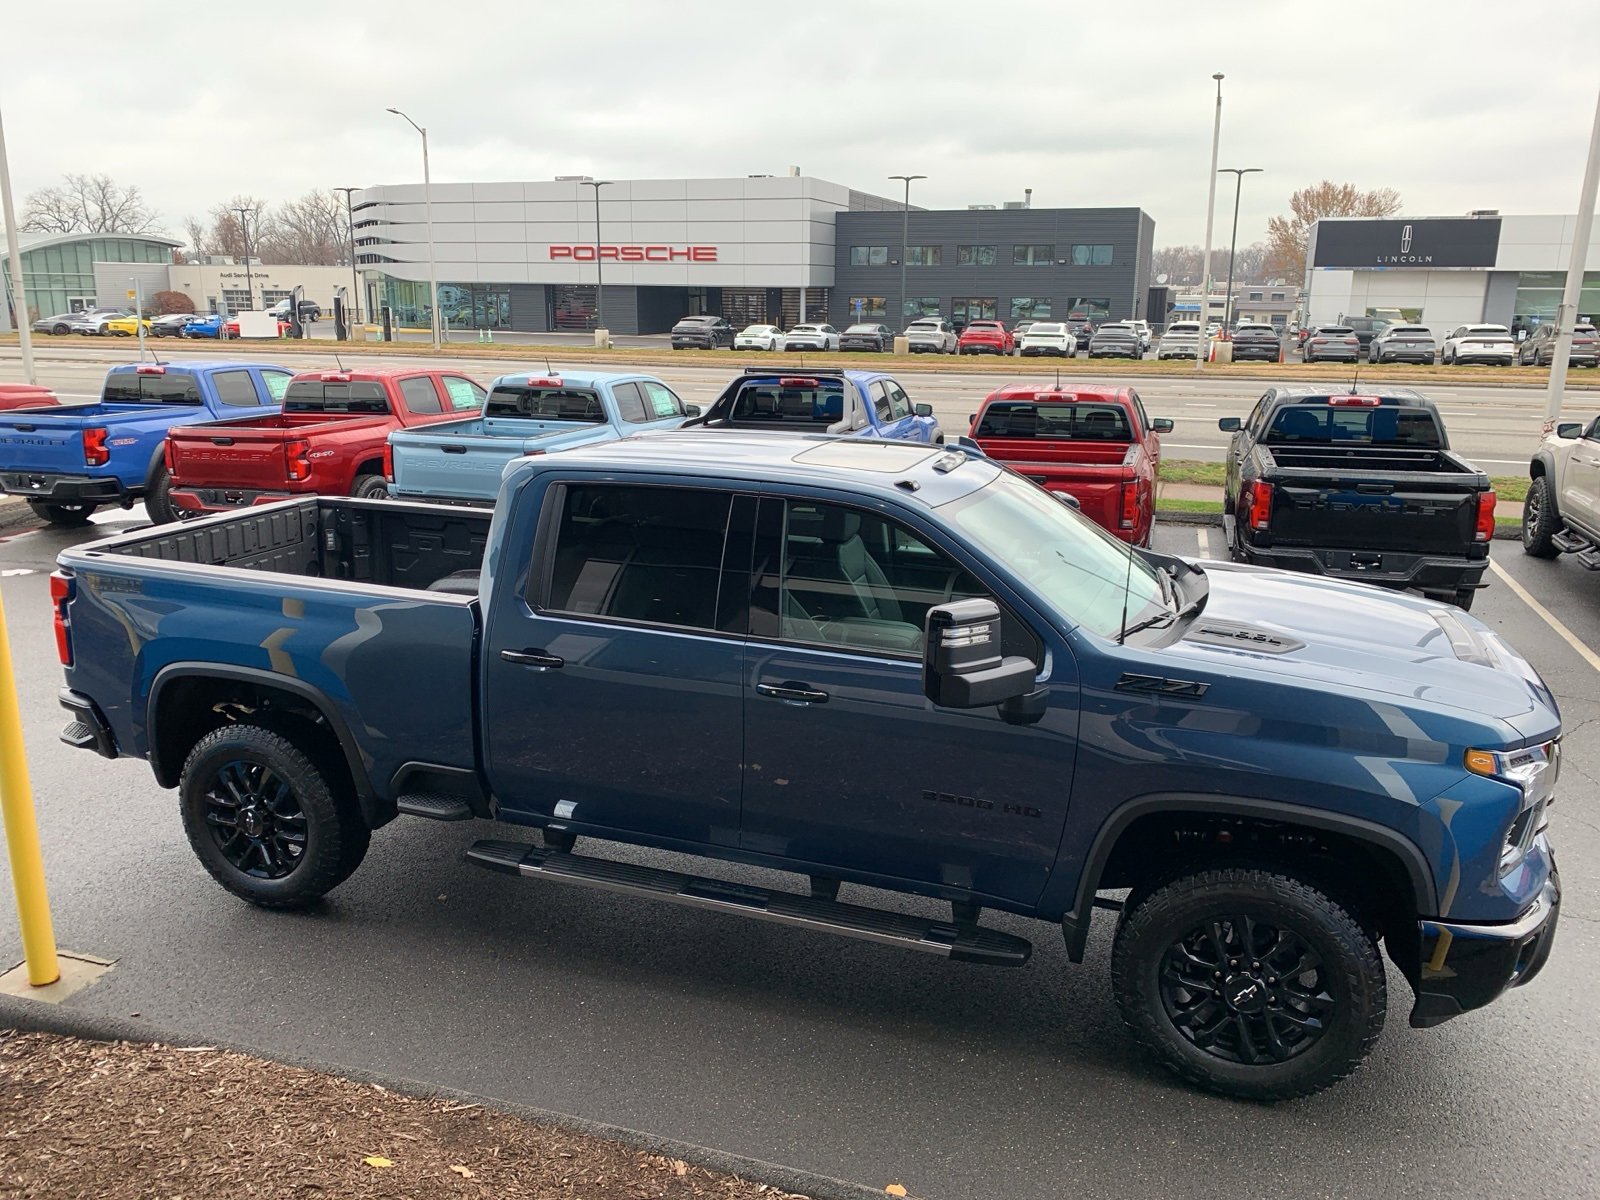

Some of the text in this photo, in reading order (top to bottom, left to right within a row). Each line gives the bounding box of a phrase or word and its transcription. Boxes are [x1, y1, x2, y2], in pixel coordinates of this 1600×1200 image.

[549, 246, 718, 261] PORSCHE
[1377, 255, 1433, 263] LINCOLN
[181, 451, 271, 462] CHEVROLET
[1295, 500, 1456, 517] CHEVROLET
[1114, 672, 1212, 699] Z71
